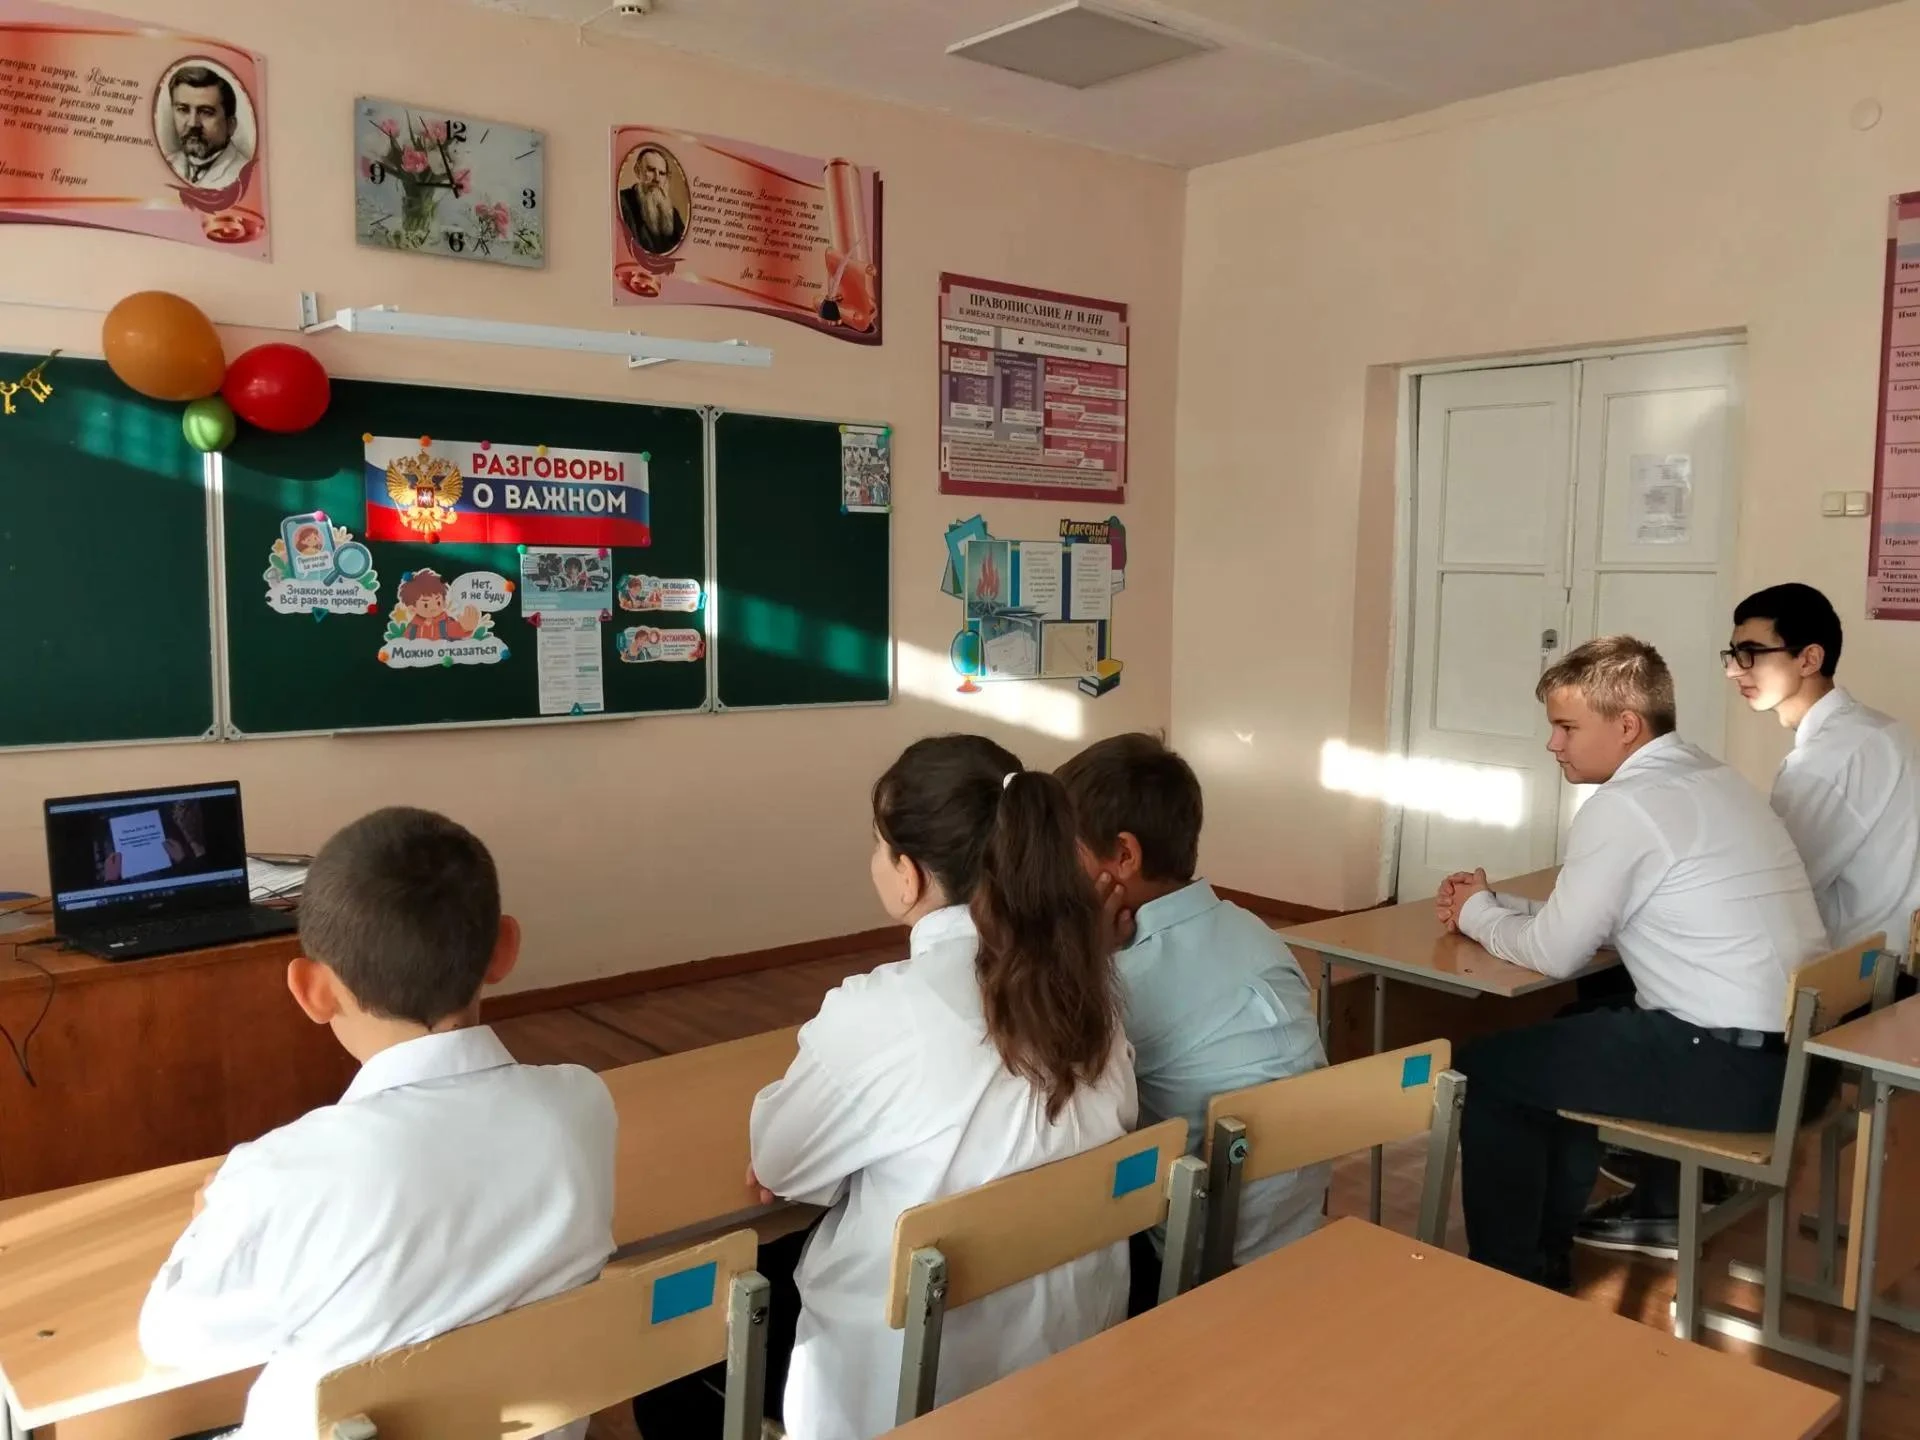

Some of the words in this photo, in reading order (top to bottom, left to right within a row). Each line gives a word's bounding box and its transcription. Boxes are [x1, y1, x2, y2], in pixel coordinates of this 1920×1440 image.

[100, 117, 115, 127] от
[445, 120, 467, 142] 12
[50, 167, 88, 186] Куприн
[370, 163, 385, 184] 9
[522, 188, 536, 209] 3
[449, 231, 464, 252] 6
[966, 308, 995, 320] ИМЕНАХ
[997, 313, 1060, 330] ПРИЛАГАТЕЛЬНЫХ
[970, 294, 1061, 319] ПРАВОПИСАНИЕ
[1065, 309, 1072, 321] Н
[1077, 312, 1085, 323] И
[1088, 313, 1103, 326] НН
[472, 453, 625, 482] РАЗГОВОРЫ
[473, 483, 494, 509] О
[505, 484, 627, 514] ВАЖНОМ
[336, 586, 360, 596] имя?
[471, 579, 493, 590] Нет,
[280, 594, 298, 605] Всё
[331, 597, 368, 608] проверь
[471, 591, 481, 600] не
[484, 590, 506, 604] буду
[391, 647, 434, 659] Можно
[437, 645, 498, 657] оказаться
